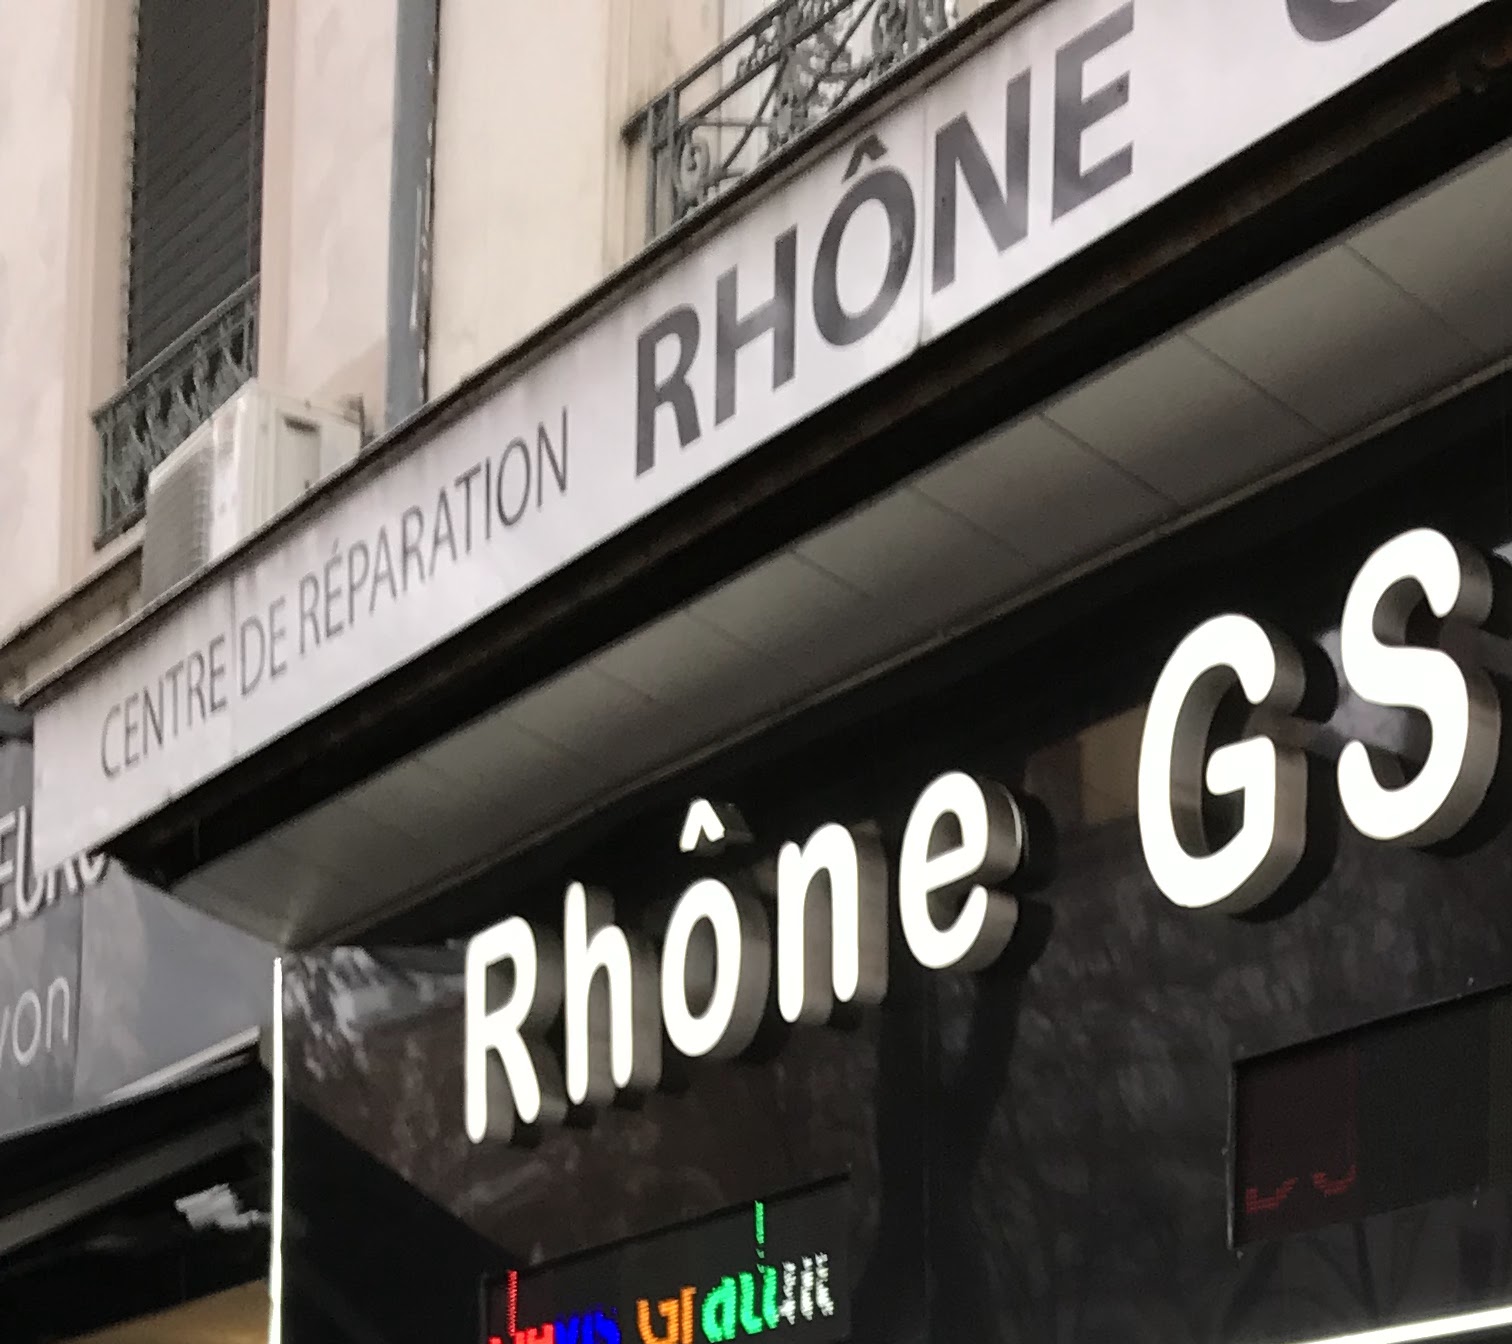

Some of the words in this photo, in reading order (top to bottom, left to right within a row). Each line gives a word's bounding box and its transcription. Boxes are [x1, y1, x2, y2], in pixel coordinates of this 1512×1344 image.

[100, 630, 228, 780] CENTRE
[239, 597, 289, 697] DE
[299, 405, 569, 656] RÉPARATION
[634, 4, 1136, 478] RHÔNE
[463, 770, 992, 1145] Rhône
